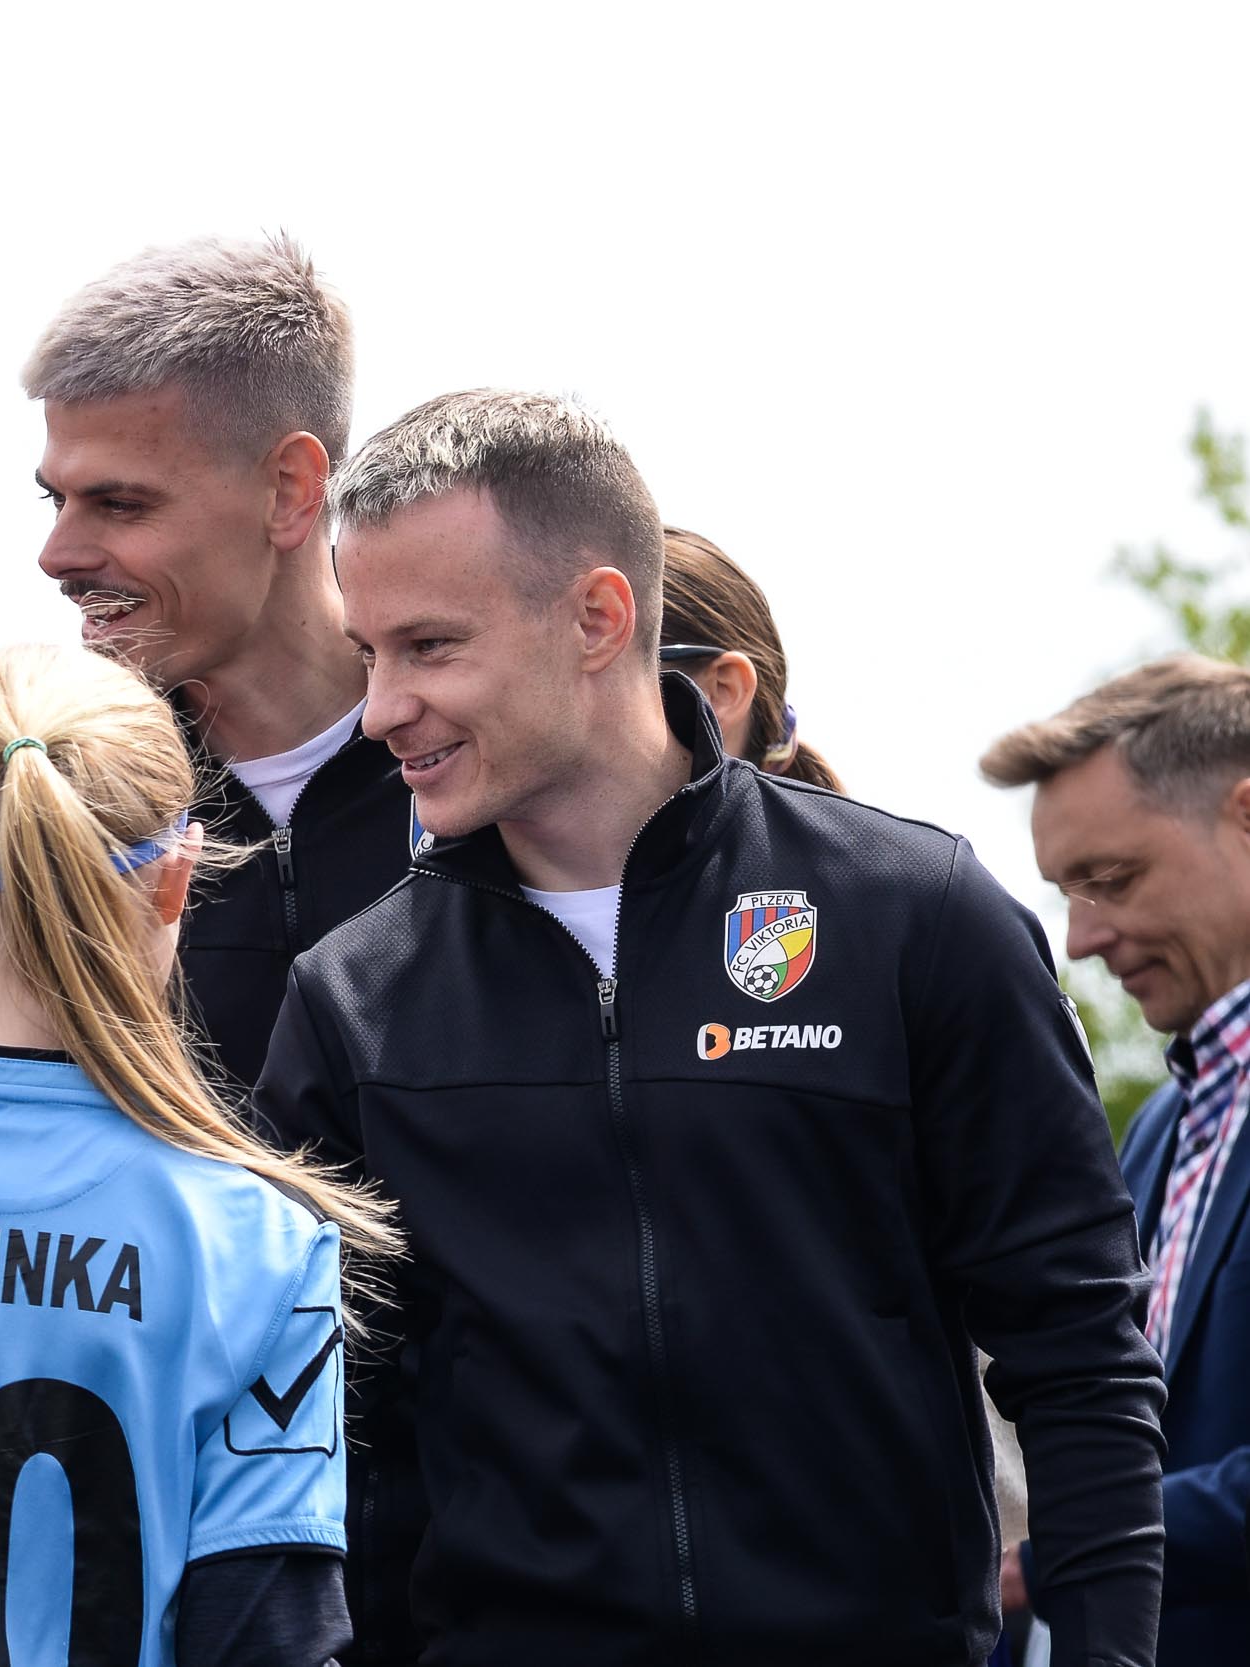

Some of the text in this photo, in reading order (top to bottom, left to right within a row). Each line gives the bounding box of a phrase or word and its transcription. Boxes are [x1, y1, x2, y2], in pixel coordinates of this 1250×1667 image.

[751, 894, 794, 907] PLZEŇ
[733, 914, 811, 973] FC VIKTORIA
[733, 1025, 842, 1050] BETANO
